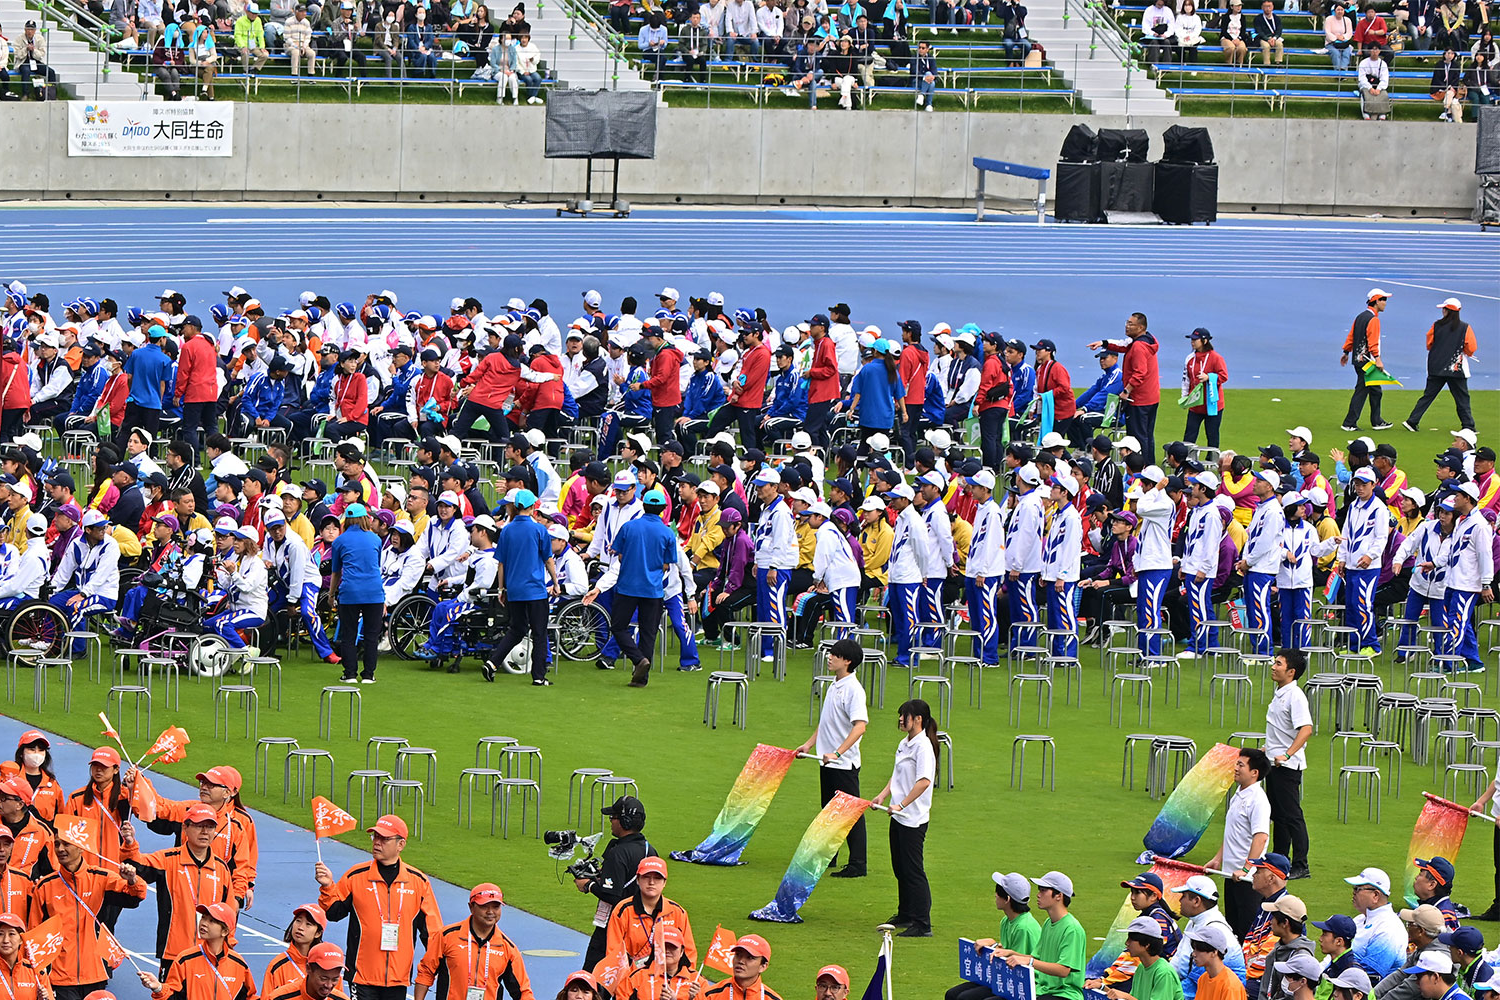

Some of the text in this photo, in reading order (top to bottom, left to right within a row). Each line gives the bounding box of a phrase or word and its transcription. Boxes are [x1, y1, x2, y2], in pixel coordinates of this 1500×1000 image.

[122, 126, 150, 136] DAIDO
[153, 120, 224, 140] 大同生命
[995, 974, 1026, 1000] 長崎県
